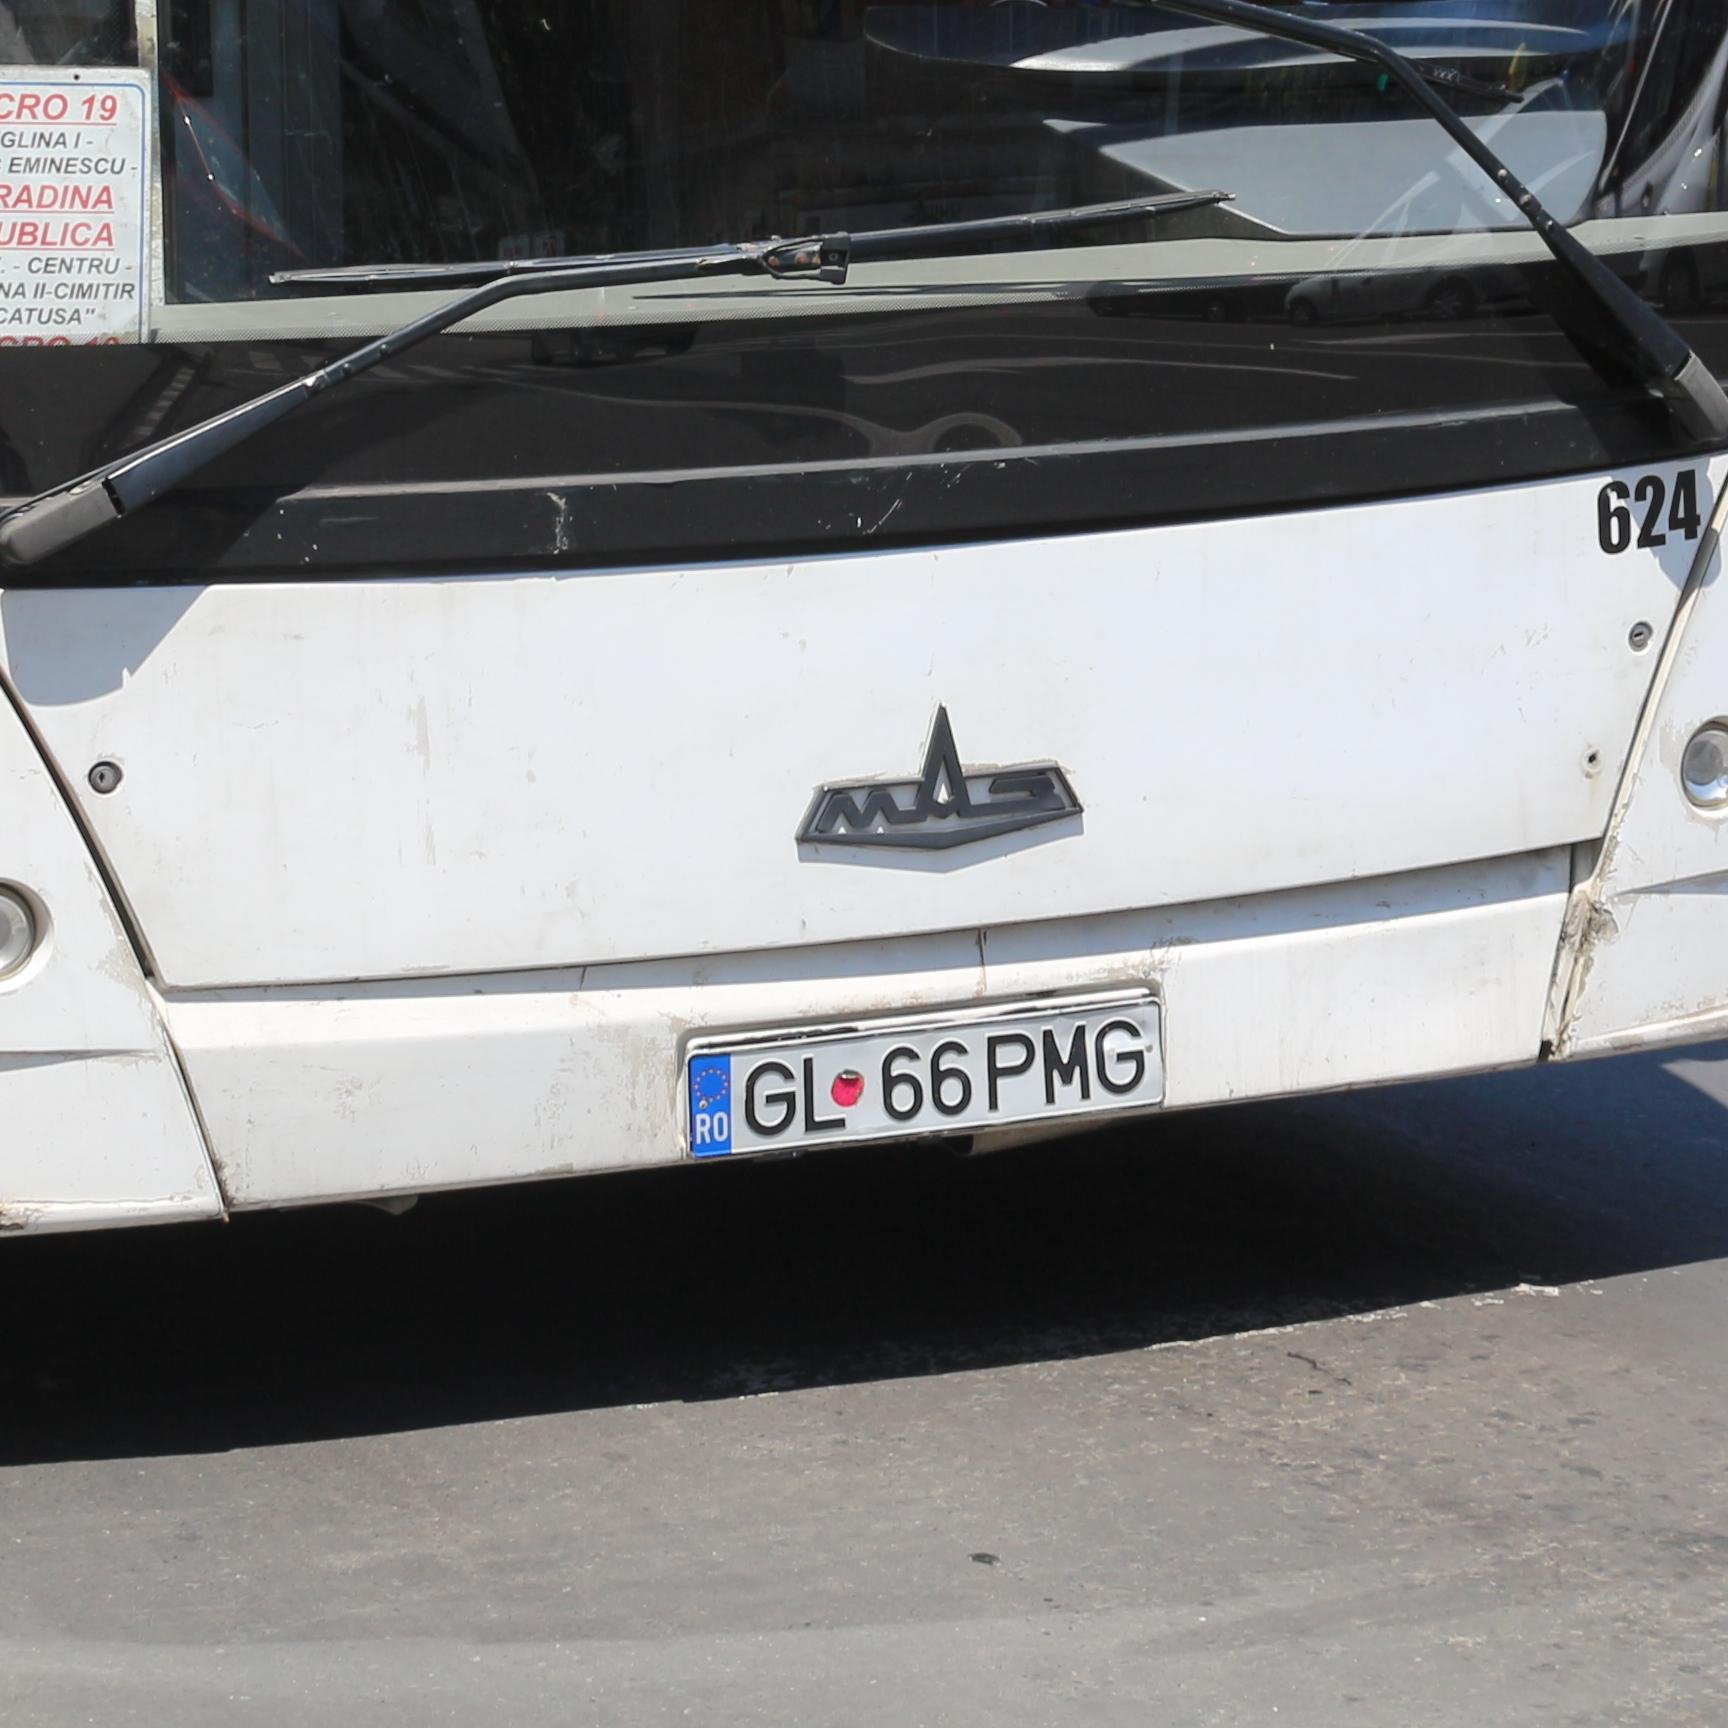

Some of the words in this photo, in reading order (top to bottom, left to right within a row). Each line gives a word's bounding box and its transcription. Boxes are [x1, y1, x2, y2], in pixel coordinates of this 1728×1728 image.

[81, 94, 118, 121] 19
[73, 132, 83, 148] I
[8, 157, 127, 177] EMINESCU
[27, 256, 119, 275] CENTRU
[32, 281, 135, 301] II-CIMITIR
[1596, 468, 1702, 556] 624
[744, 1056, 846, 1138] GL
[695, 1111, 730, 1146] RO
